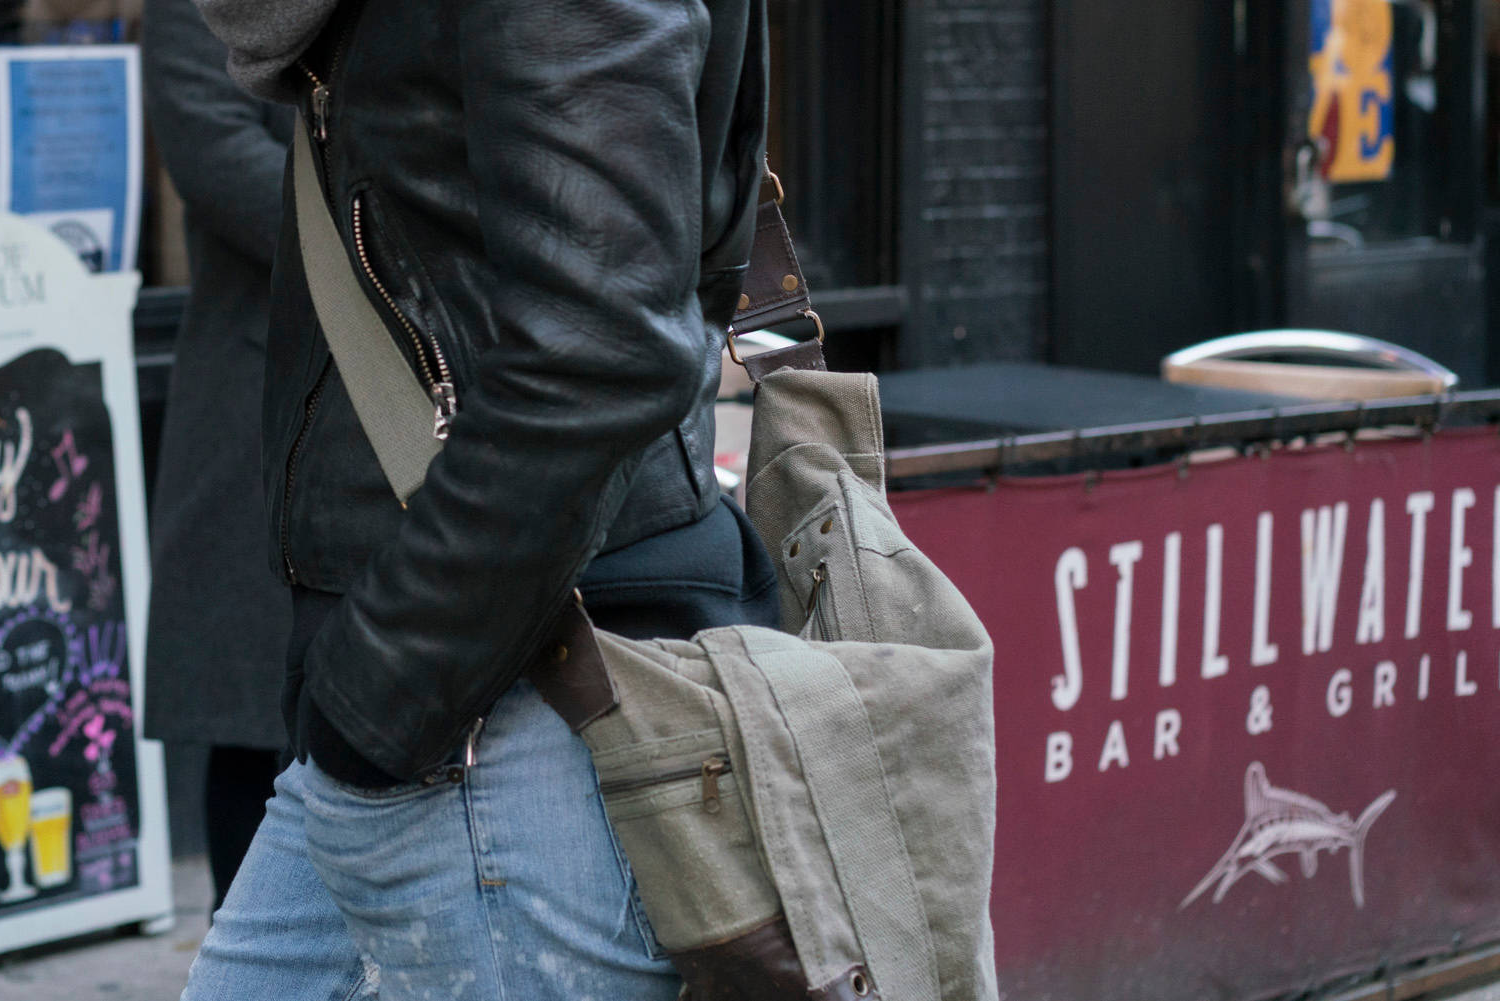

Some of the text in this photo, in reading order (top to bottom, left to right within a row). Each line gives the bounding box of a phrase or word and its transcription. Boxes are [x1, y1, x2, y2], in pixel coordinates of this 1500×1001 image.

[1051, 484, 1500, 711] STILLWATE
[1045, 649, 1500, 783] BAR & GRIL
